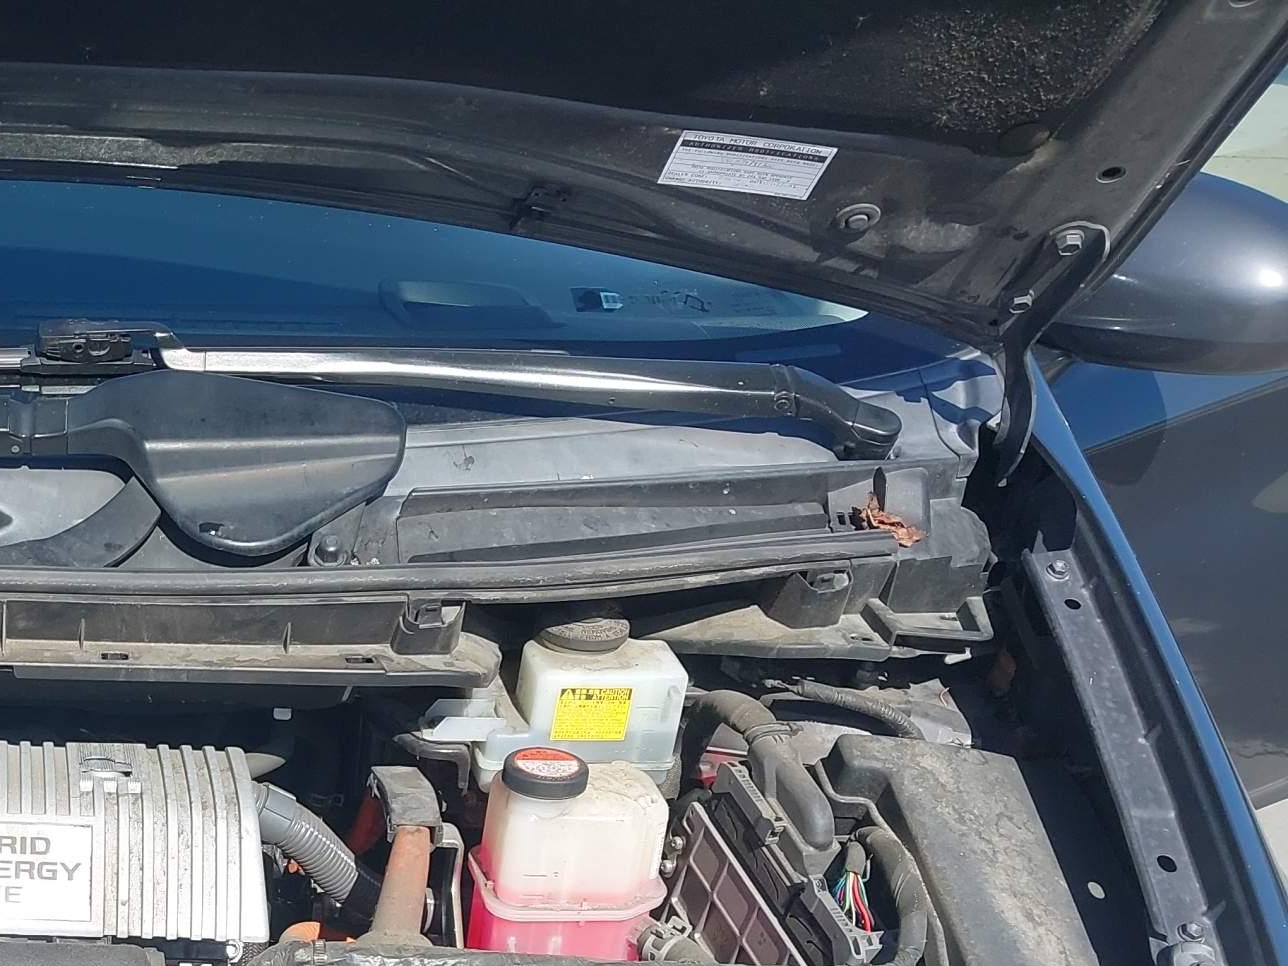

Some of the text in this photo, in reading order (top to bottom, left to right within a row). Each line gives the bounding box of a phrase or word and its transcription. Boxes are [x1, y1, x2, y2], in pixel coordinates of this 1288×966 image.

[693, 134, 823, 155] TOYOTA MOTOR CORPORATION
